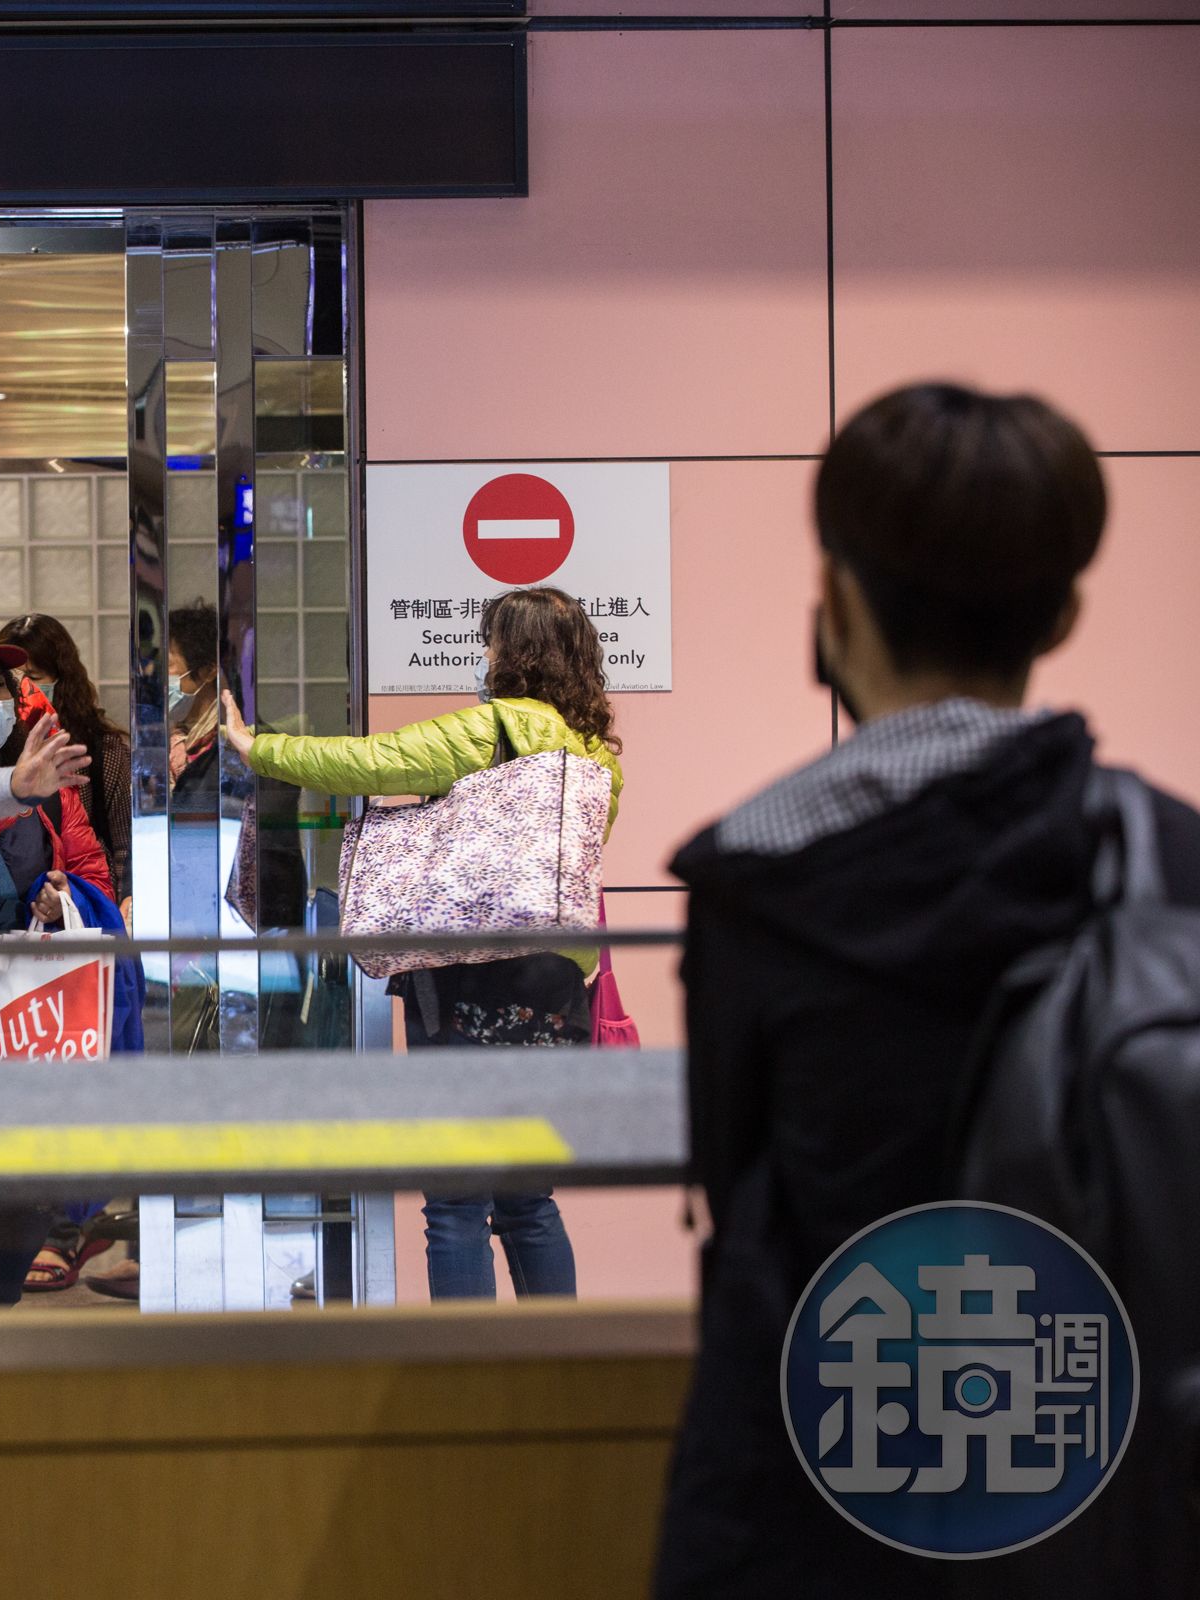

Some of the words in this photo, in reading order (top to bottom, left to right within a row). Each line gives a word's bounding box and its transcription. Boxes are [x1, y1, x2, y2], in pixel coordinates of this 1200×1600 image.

[408, 651, 483, 667] Authoriz
[608, 649, 645, 669] only
[650, 682, 664, 690] Law
